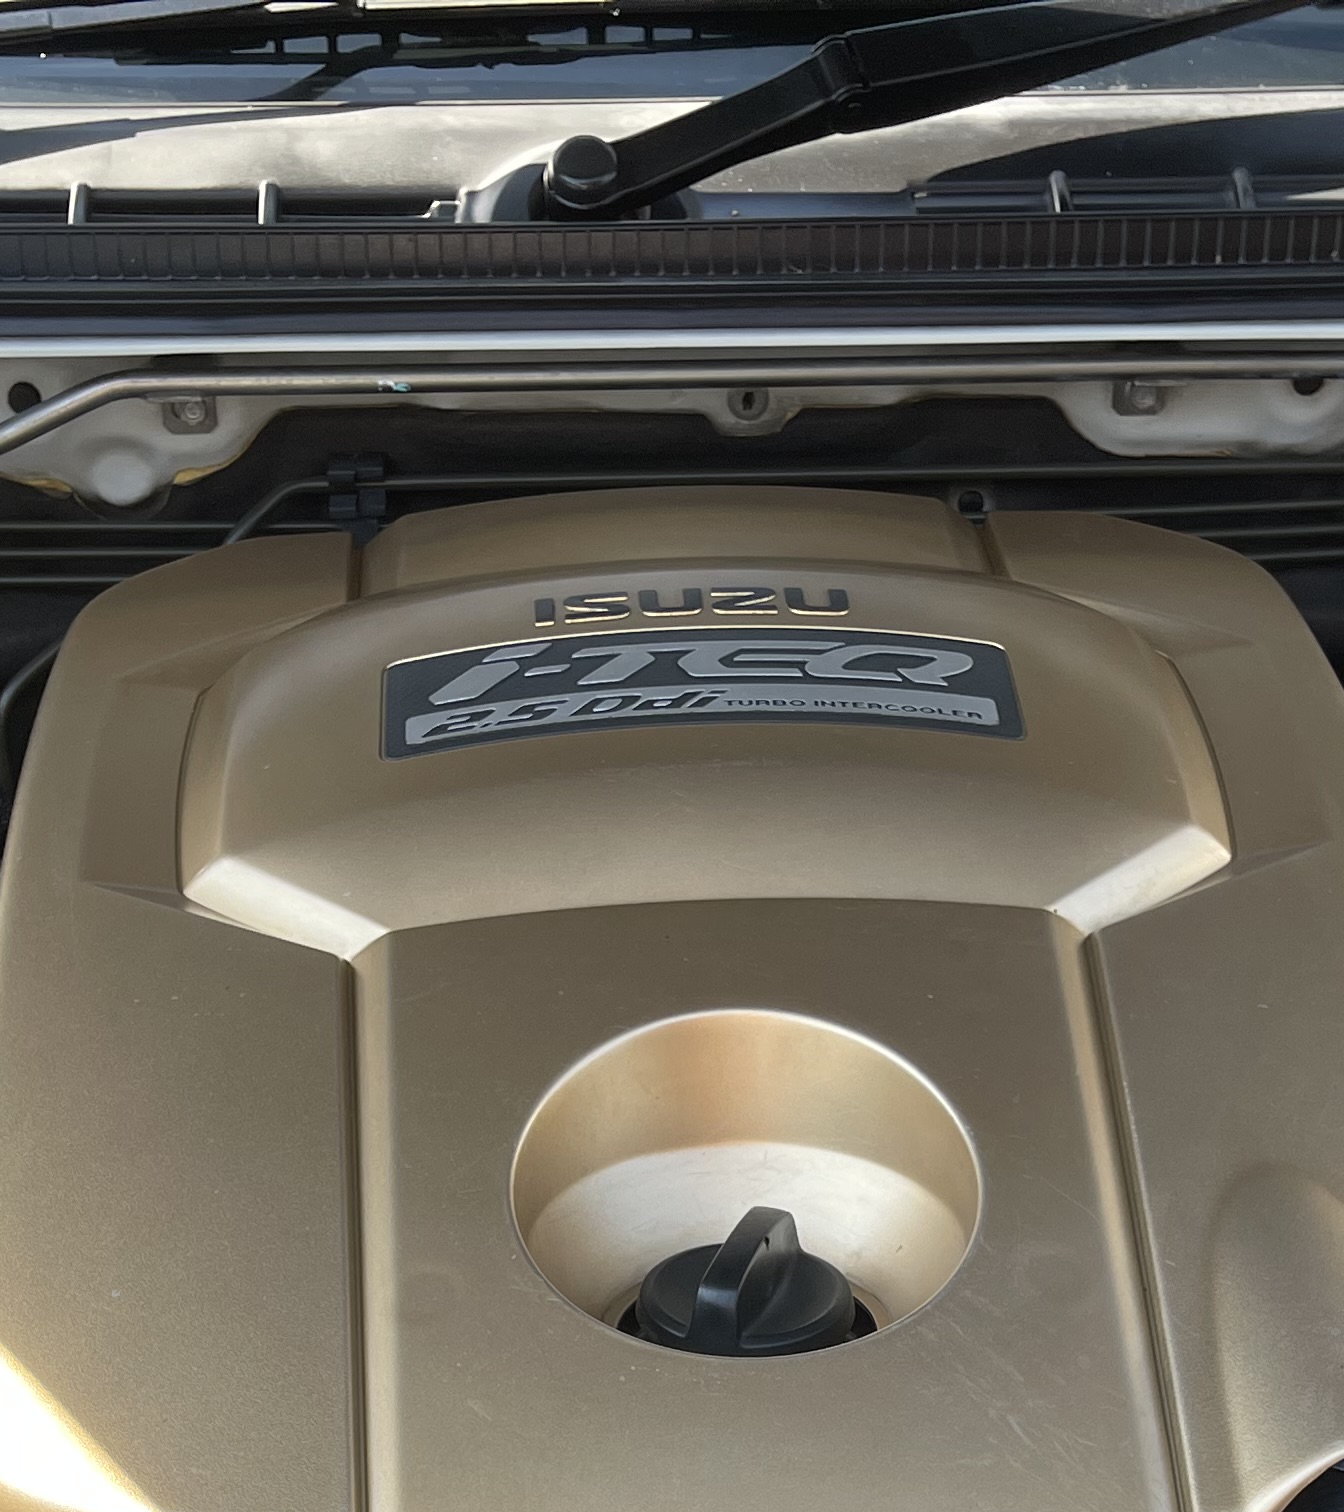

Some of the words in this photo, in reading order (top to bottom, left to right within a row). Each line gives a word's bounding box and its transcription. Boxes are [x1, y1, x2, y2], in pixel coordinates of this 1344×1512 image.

[534, 587, 849, 627] ISUZU
[422, 700, 570, 738] 2.5
[726, 699, 806, 708] TURBO
[814, 699, 984, 721] INTERCOOLER
